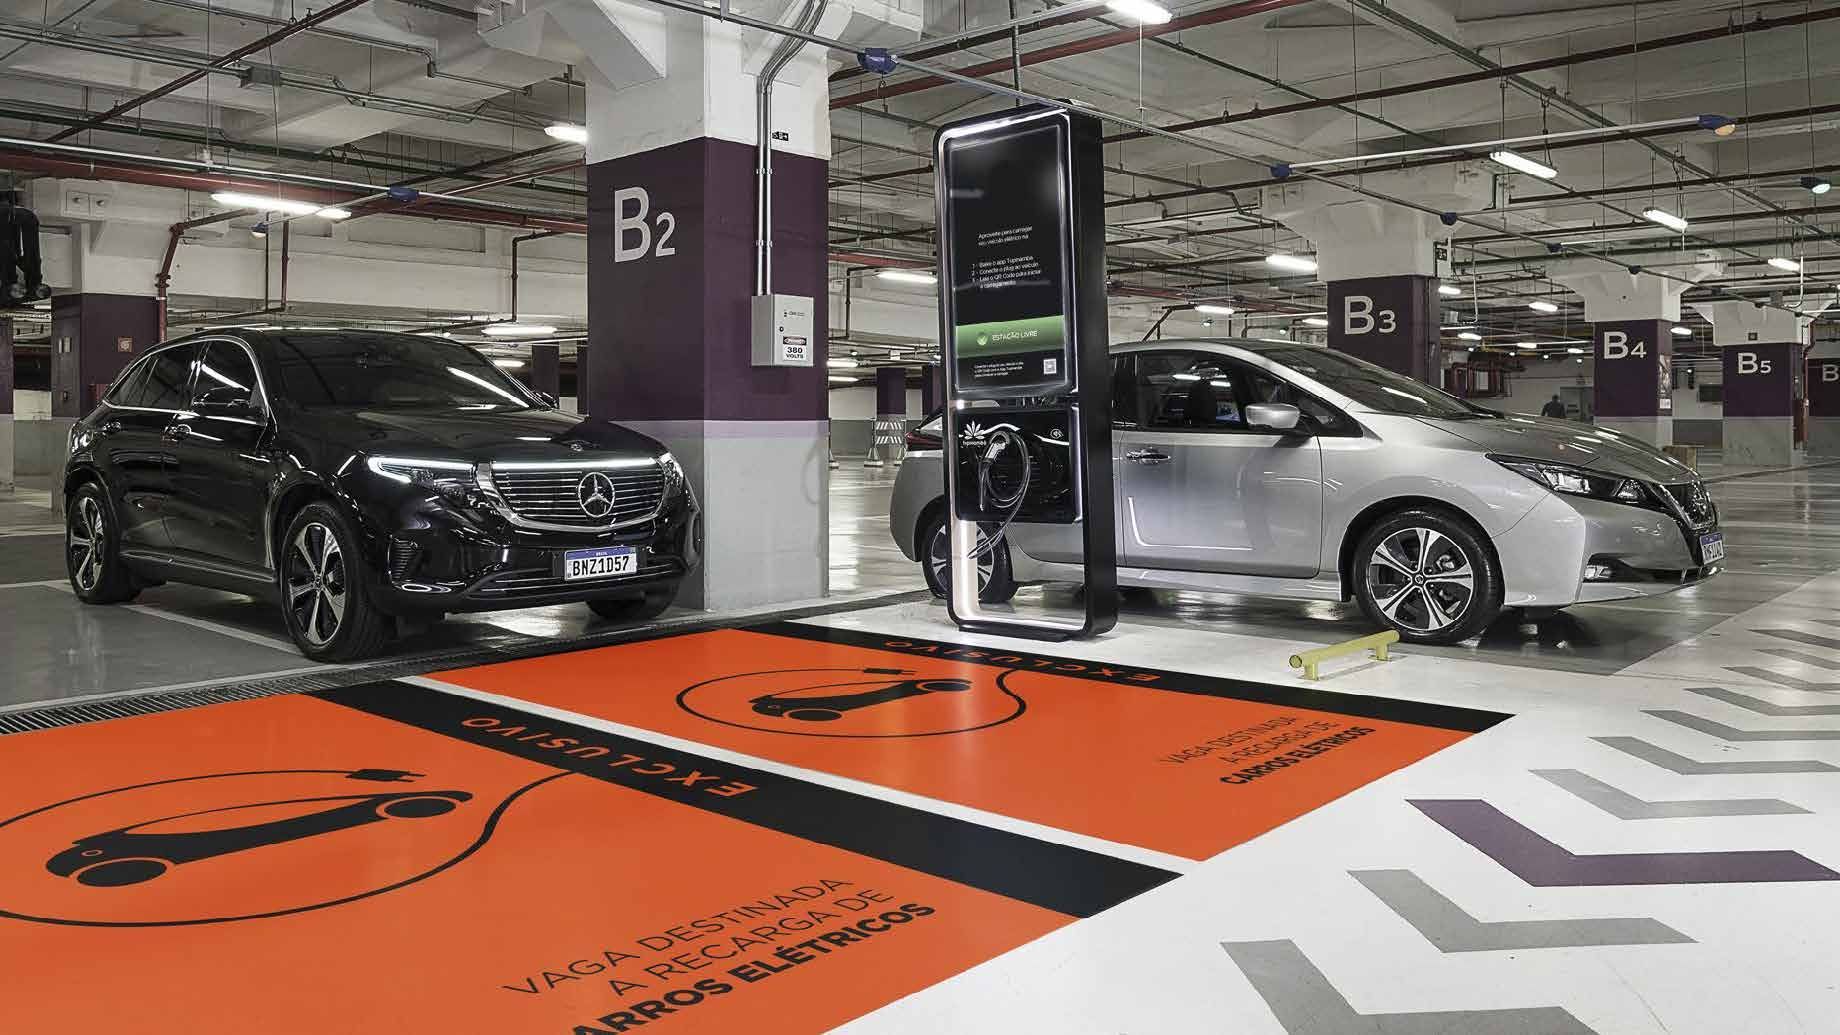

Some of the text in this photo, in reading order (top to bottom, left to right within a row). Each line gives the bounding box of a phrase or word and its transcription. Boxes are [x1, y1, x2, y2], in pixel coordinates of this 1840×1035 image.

[614, 186, 675, 263] B2
[1020, 330, 1038, 338] LIVRE
[1344, 294, 1397, 335] B3
[787, 346, 803, 354] 380
[1603, 331, 1647, 360] B4
[1737, 352, 1772, 374] B5
[573, 556, 629, 576] BNZ1D57
[884, 641, 1161, 682] EXCLUSIVO
[462, 717, 760, 798] EXCLUSIVO
[1160, 715, 1299, 765] VAGA DESTINADA
[1219, 726, 1377, 785] CARROS ELÉTRICOS
[1231, 730, 1313, 758] RECARGA
[502, 878, 854, 997] VAGA DESTINADA
[608, 888, 895, 997] A RECARGA DE
[726, 902, 936, 984] ELÉTRICOS
